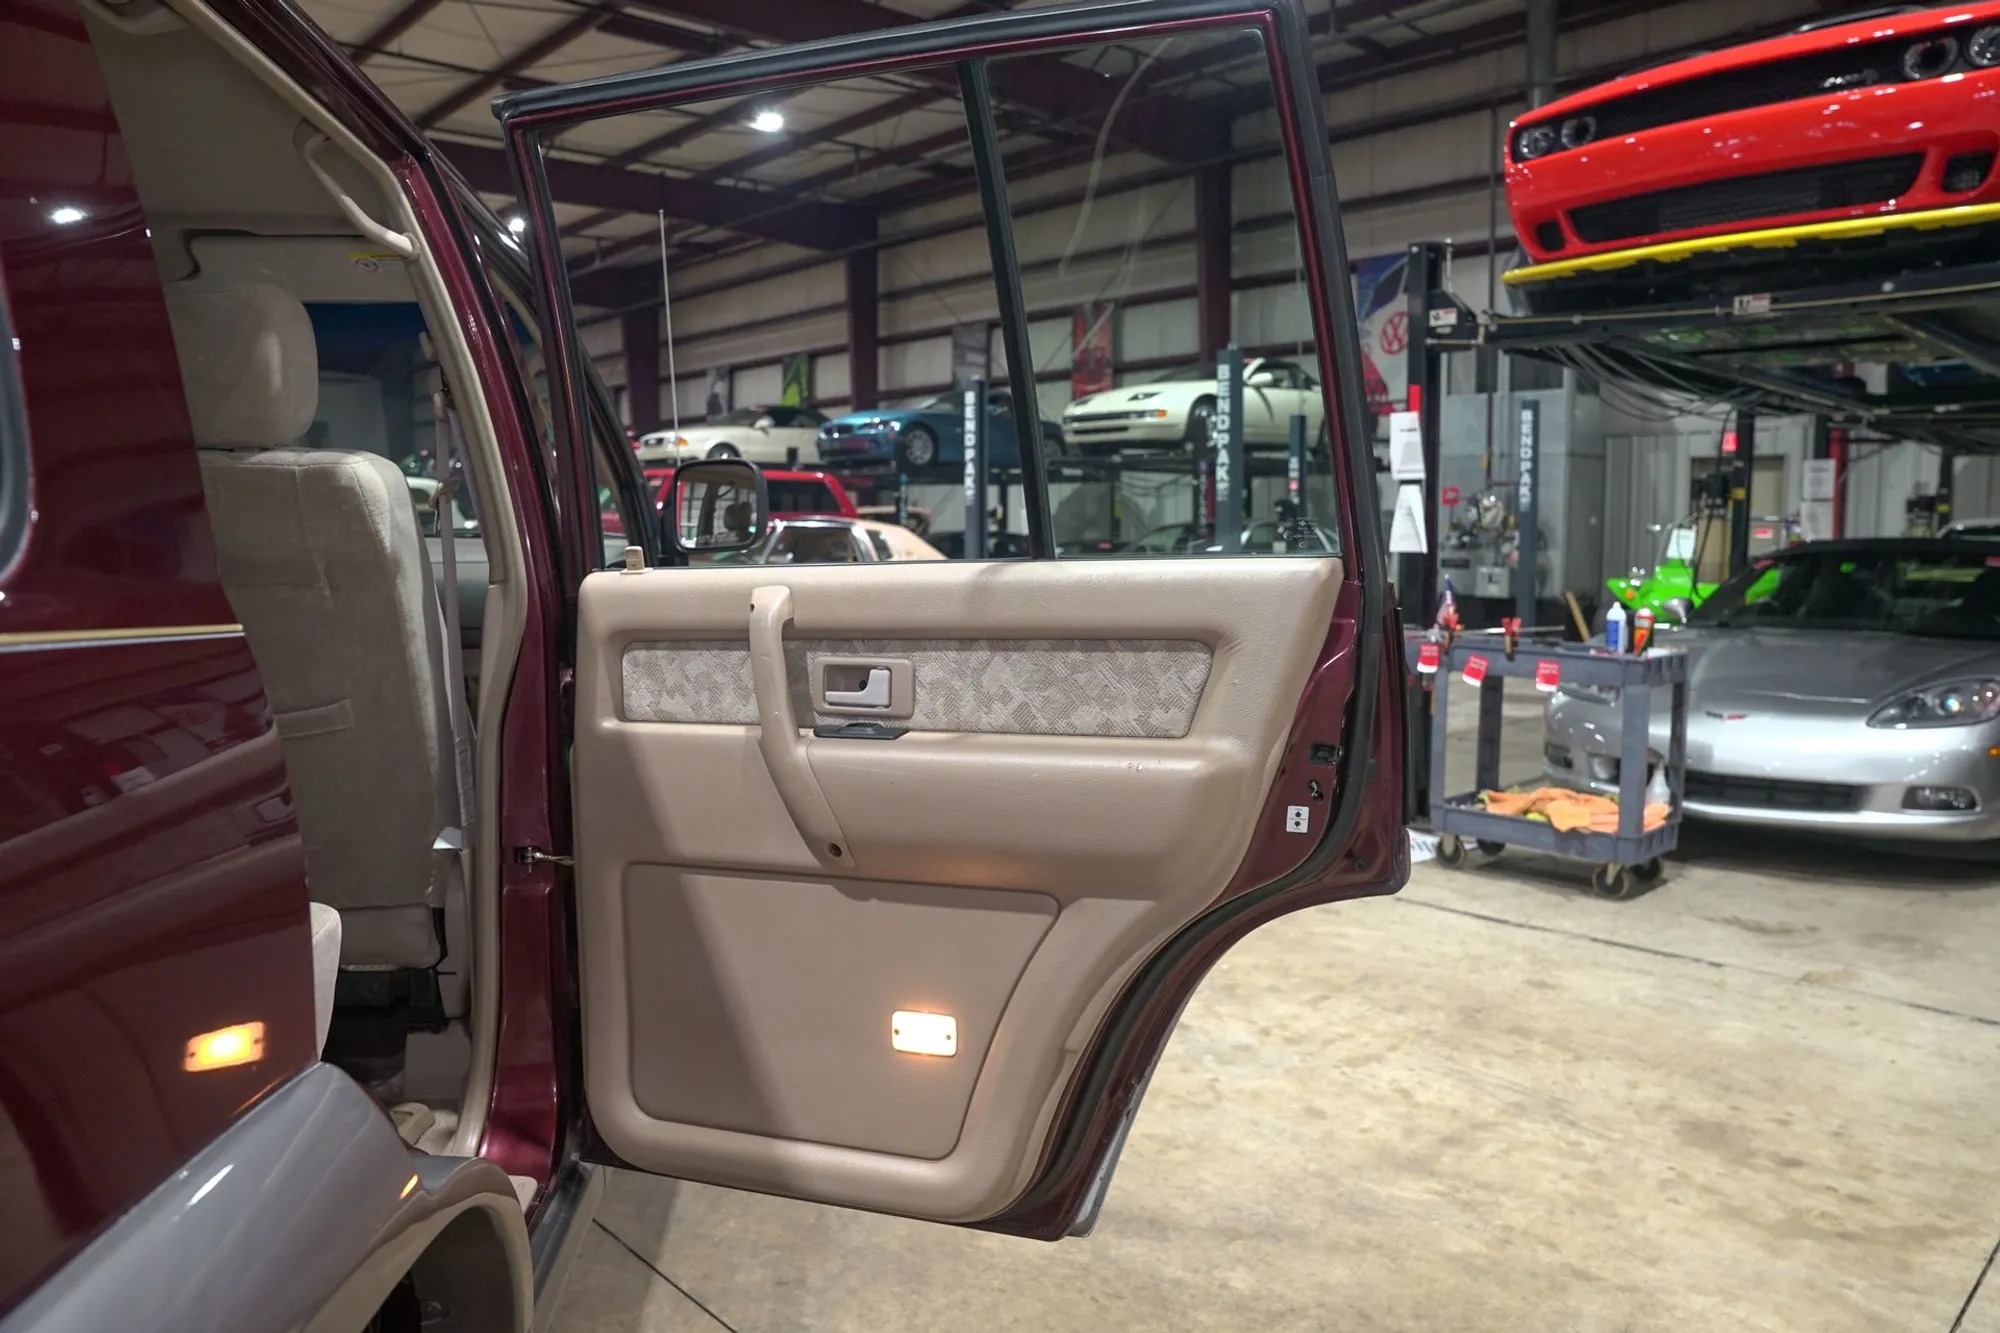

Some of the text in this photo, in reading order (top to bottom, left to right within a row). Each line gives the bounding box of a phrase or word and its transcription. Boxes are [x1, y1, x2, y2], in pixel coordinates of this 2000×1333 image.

[964, 390, 976, 489] BENDPAK
[1216, 363, 1230, 482] BENDPAK
[1520, 409, 1533, 498] BENDPAK
